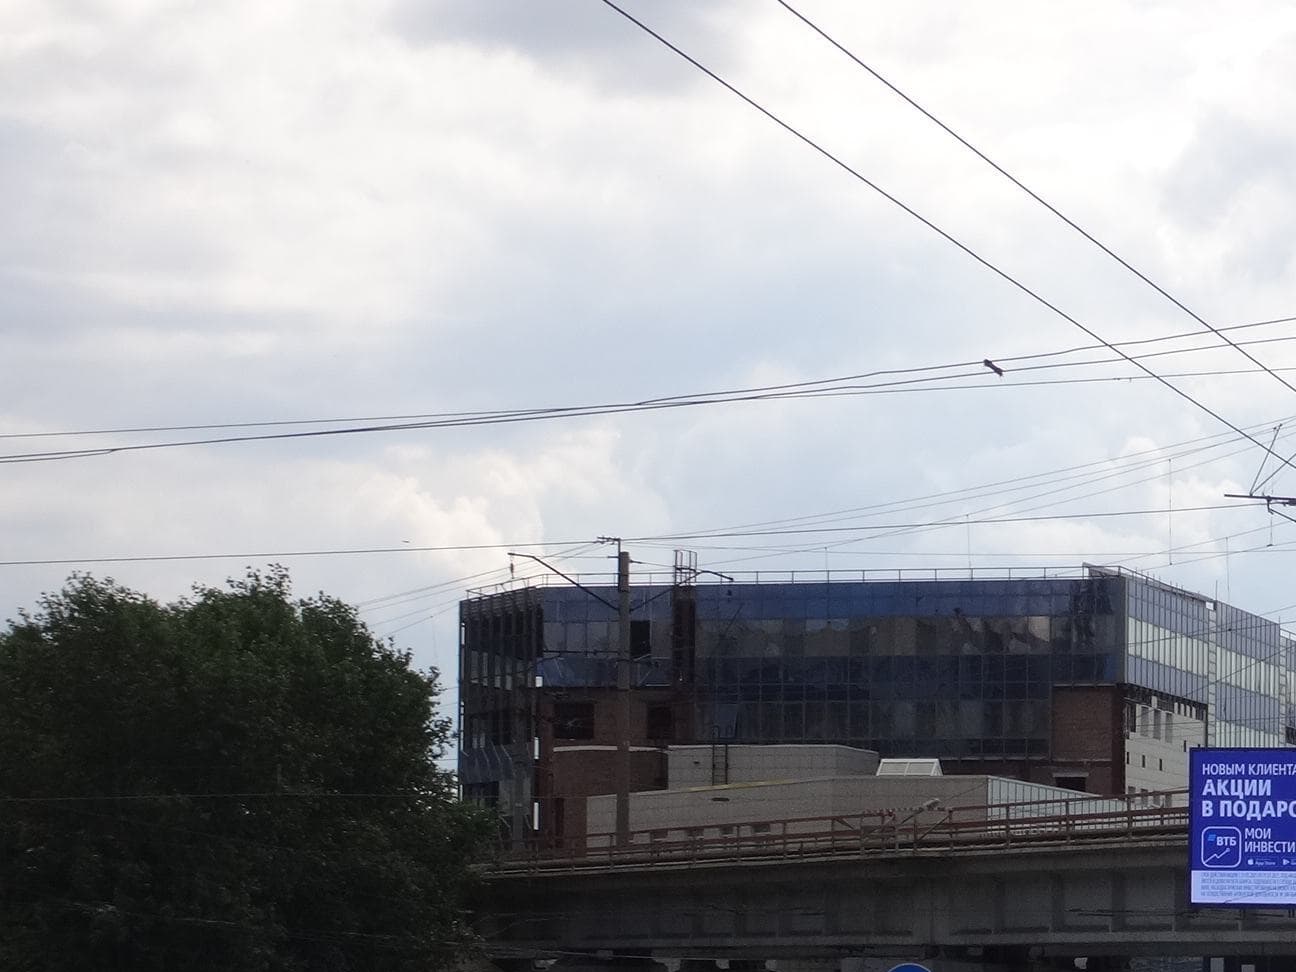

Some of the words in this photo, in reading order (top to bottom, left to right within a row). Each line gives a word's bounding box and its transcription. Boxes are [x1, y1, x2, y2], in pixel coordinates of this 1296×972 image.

[1202, 763, 1245, 776] НОВЫМ
[1202, 778, 1272, 799] АКЦИИ
[1202, 800, 1214, 818] В
[1244, 827, 1272, 840] МОИ
[1216, 836, 1237, 846] ВТБ
